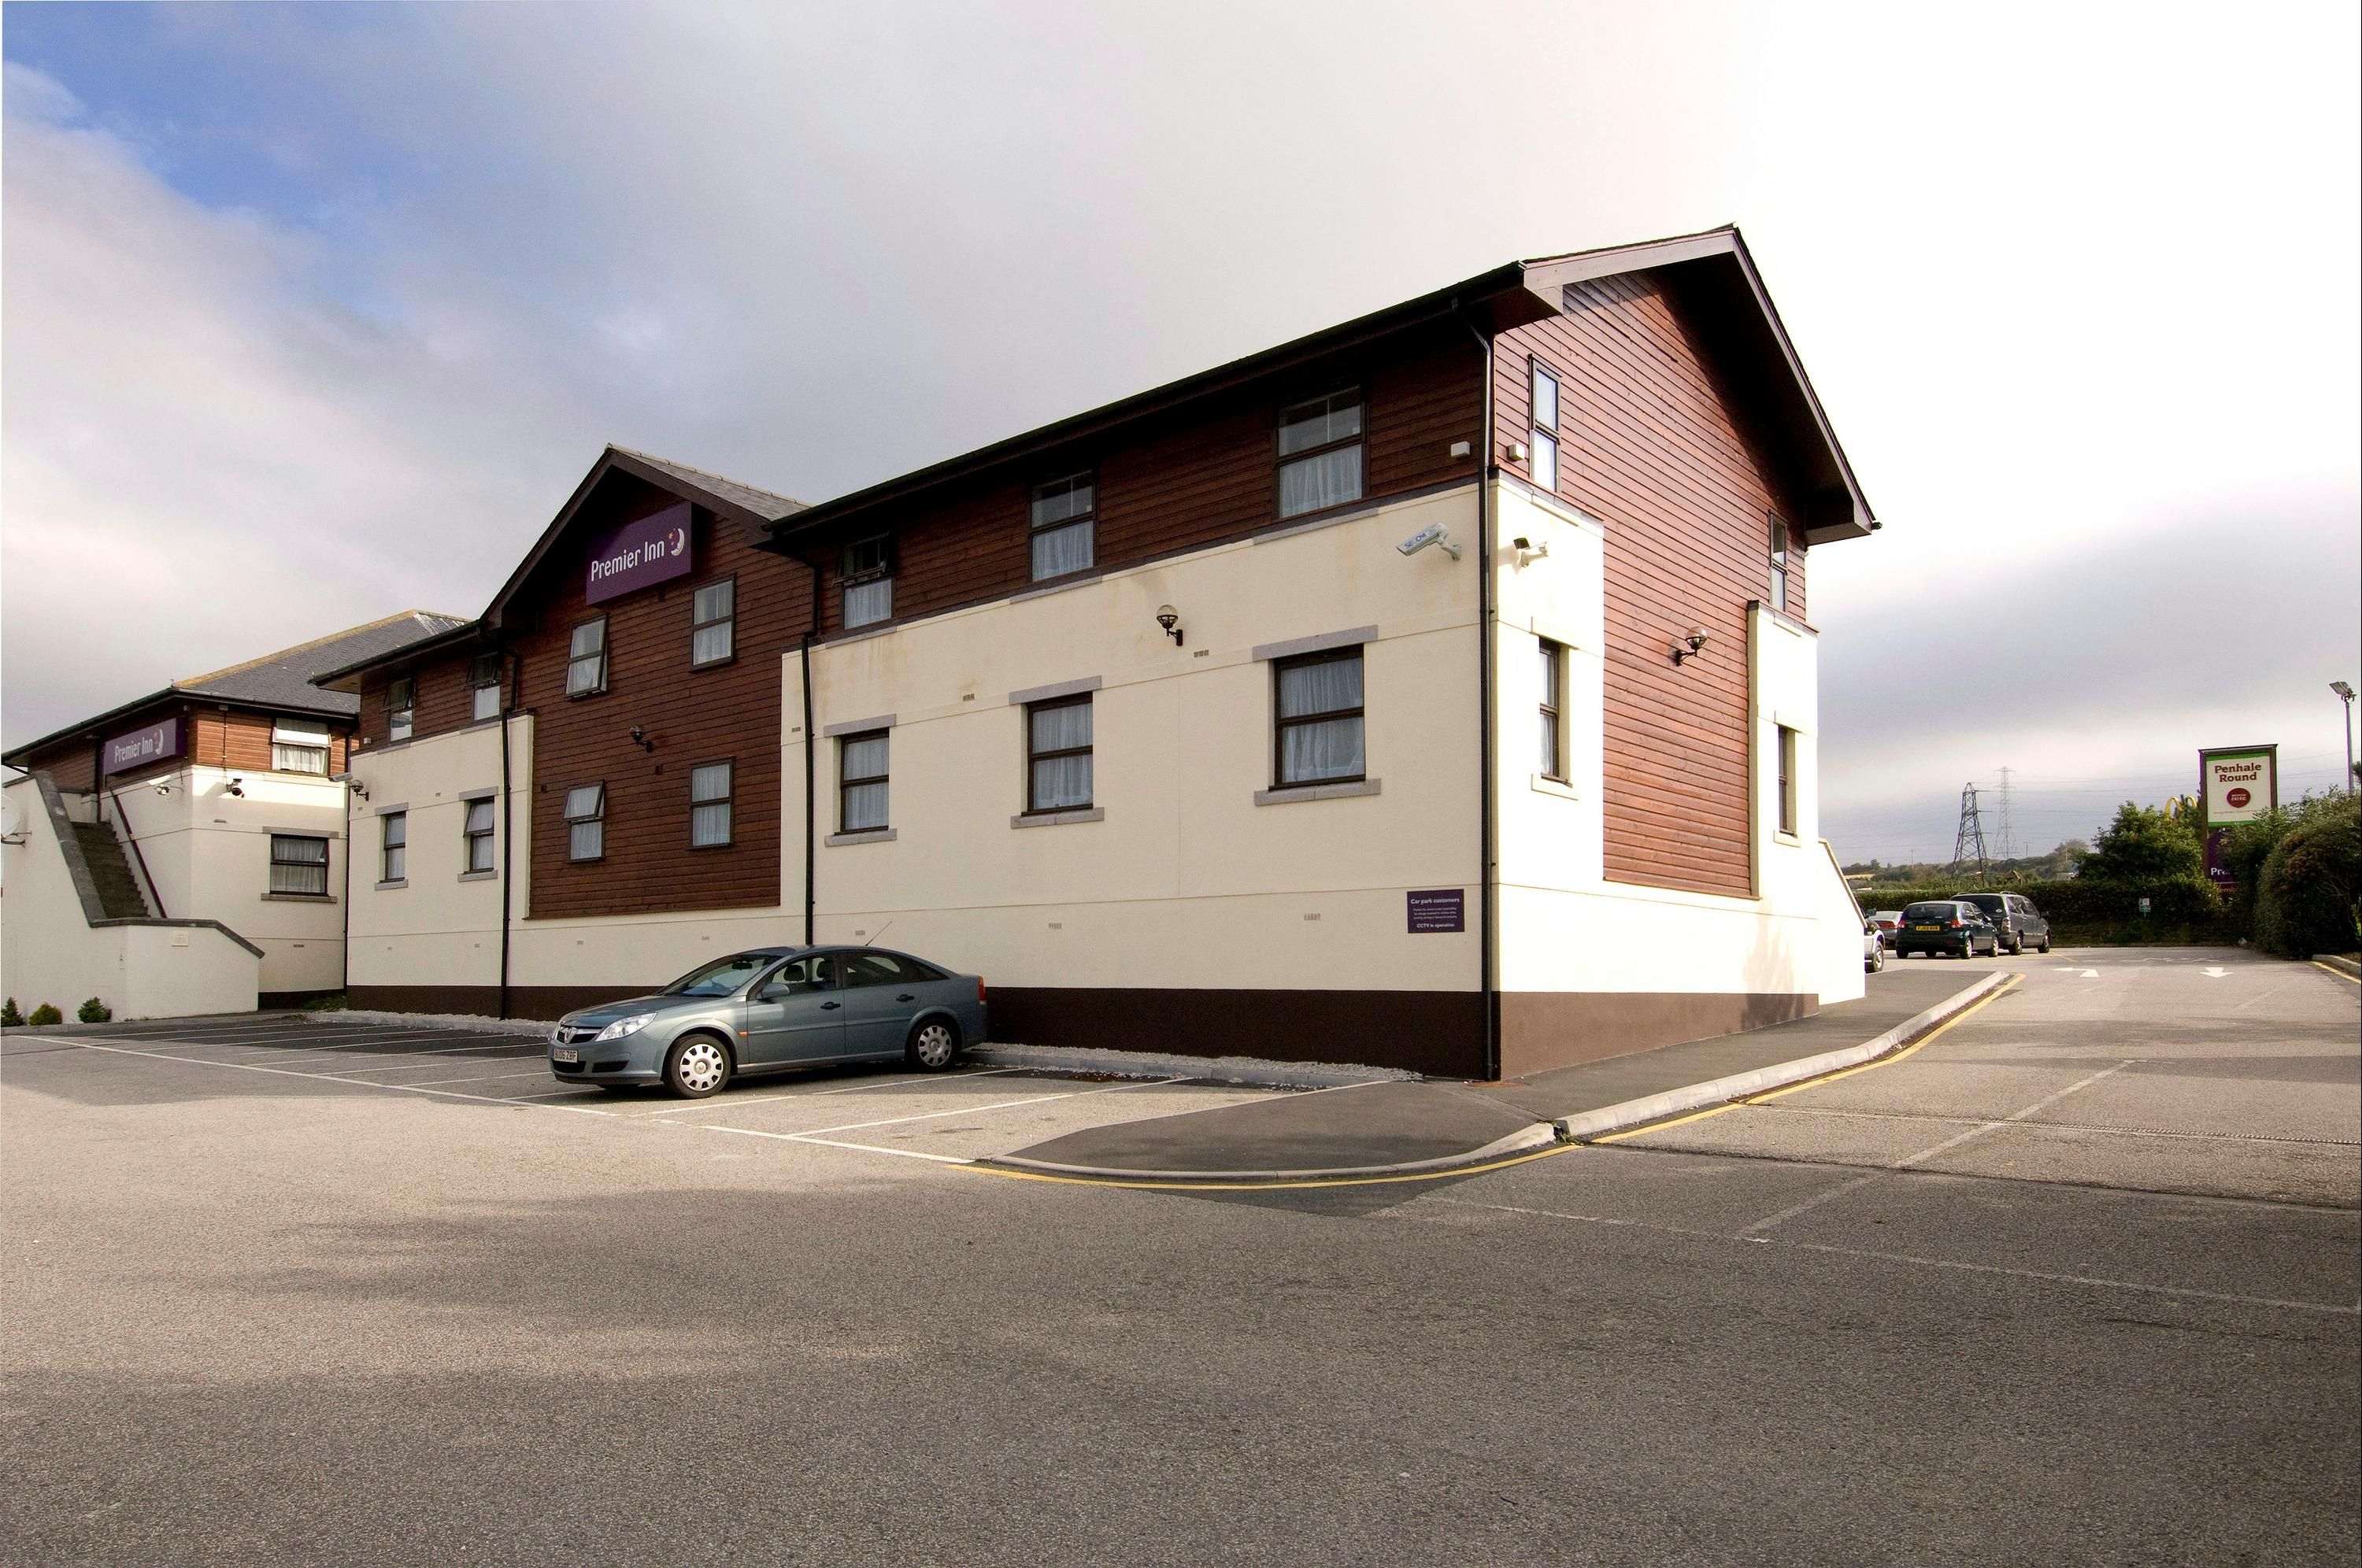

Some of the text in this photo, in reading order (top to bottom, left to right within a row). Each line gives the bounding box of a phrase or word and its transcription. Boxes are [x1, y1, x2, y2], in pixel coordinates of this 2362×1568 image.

[591, 540, 665, 582] Premier Inn
[114, 736, 154, 764] Premier Inn
[2214, 763, 2262, 774] Penhale
[2219, 771, 2257, 782] Round
